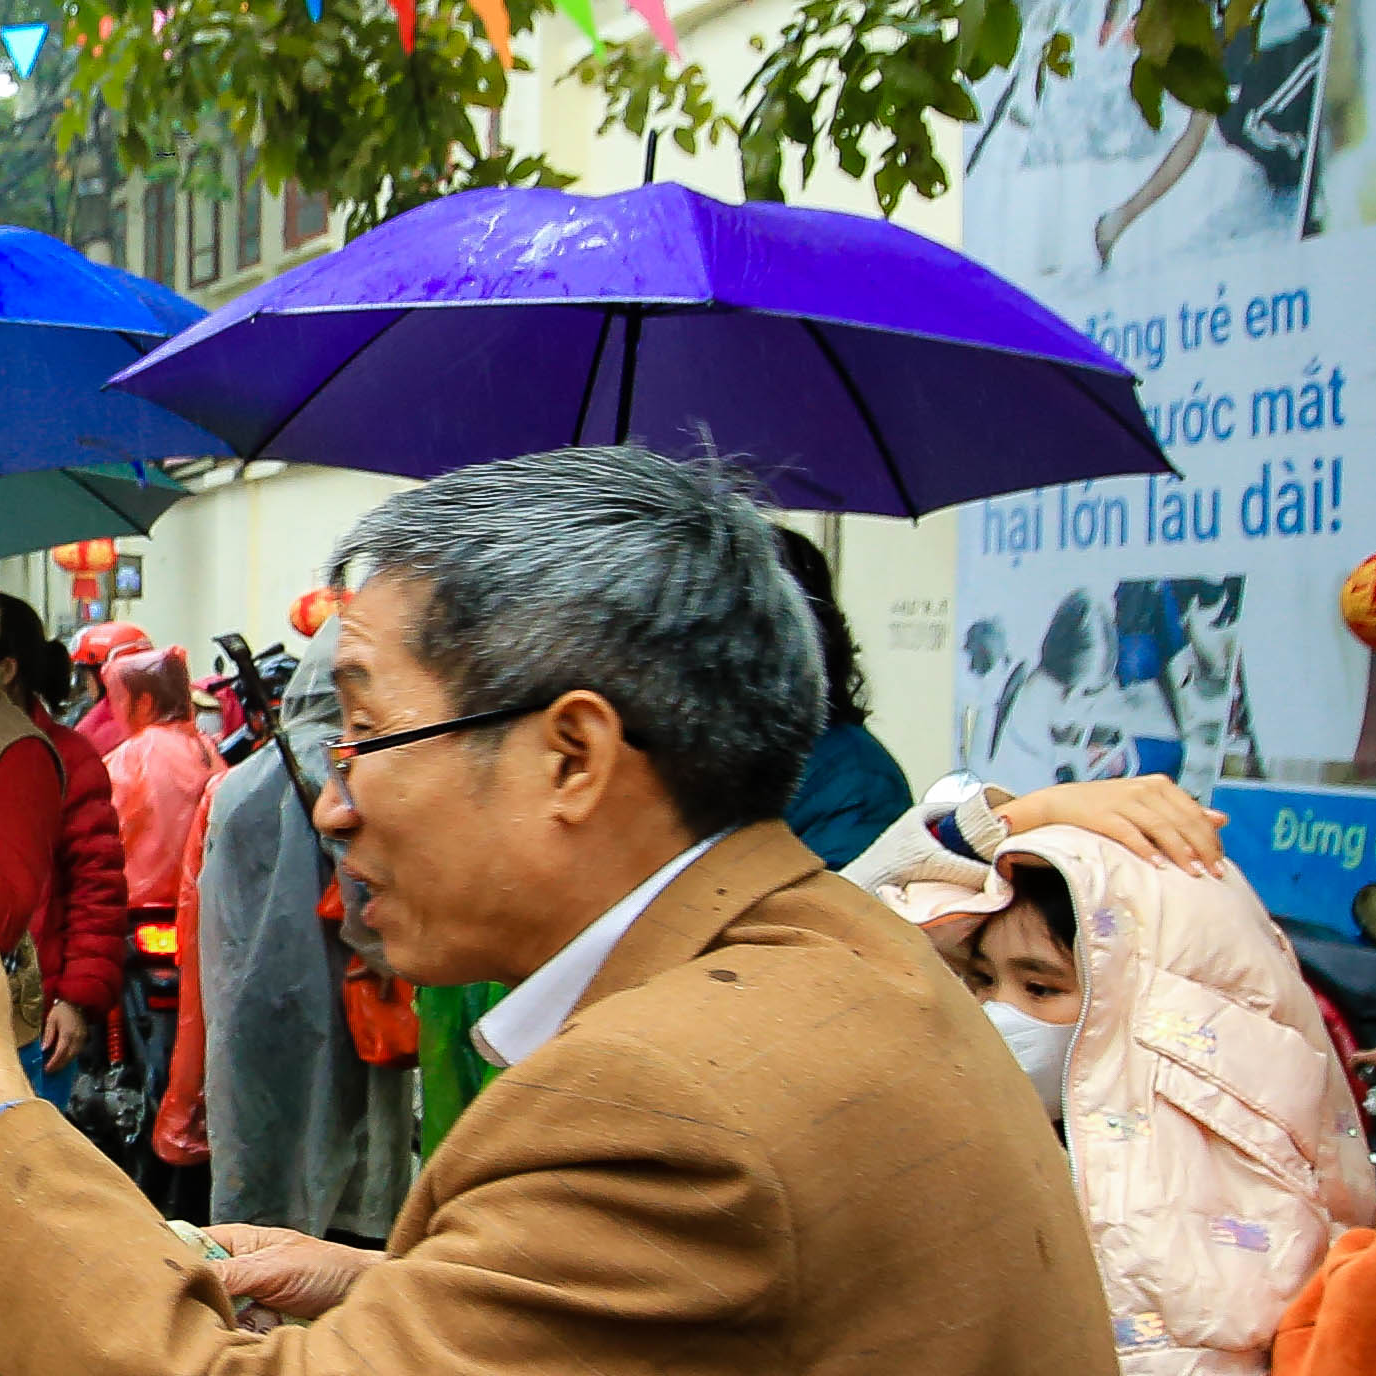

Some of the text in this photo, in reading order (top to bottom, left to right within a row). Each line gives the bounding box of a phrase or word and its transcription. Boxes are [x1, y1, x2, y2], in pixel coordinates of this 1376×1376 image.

[1179, 282, 1232, 350] trẻ
[1245, 288, 1311, 338] em
[1146, 355, 1346, 447] ước mắt
[983, 487, 1043, 567] hại
[1059, 479, 1129, 550] lớn
[1240, 455, 1343, 537] dài!
